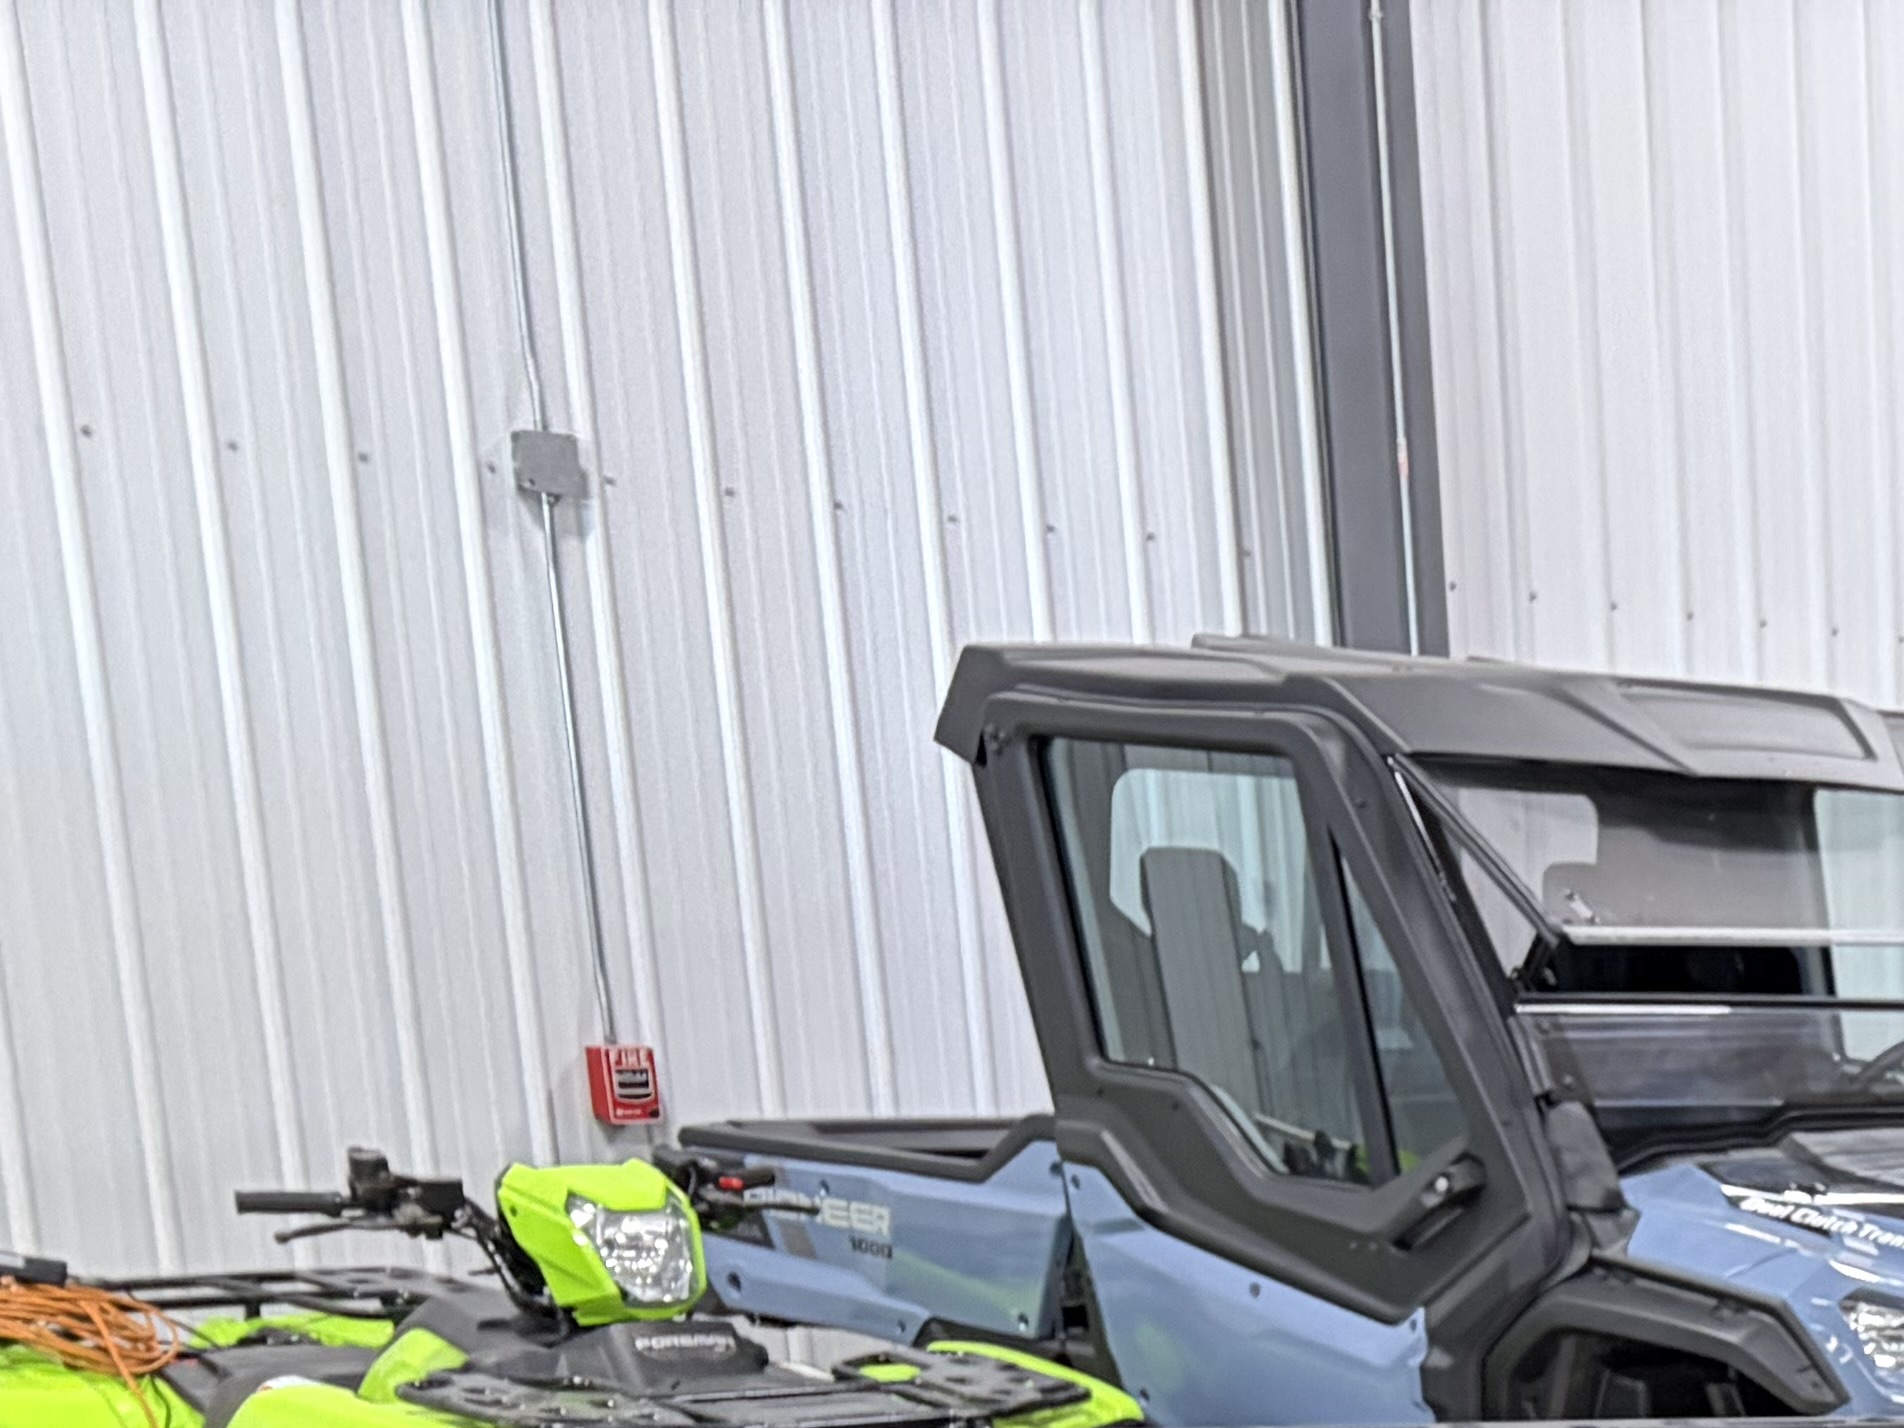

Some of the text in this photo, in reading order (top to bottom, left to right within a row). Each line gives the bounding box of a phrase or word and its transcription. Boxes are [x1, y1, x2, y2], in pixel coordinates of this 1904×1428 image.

[608, 1047, 650, 1068] FIRE
[1740, 1197, 1787, 1219] Dual
[1790, 1204, 1859, 1234] Clutch
